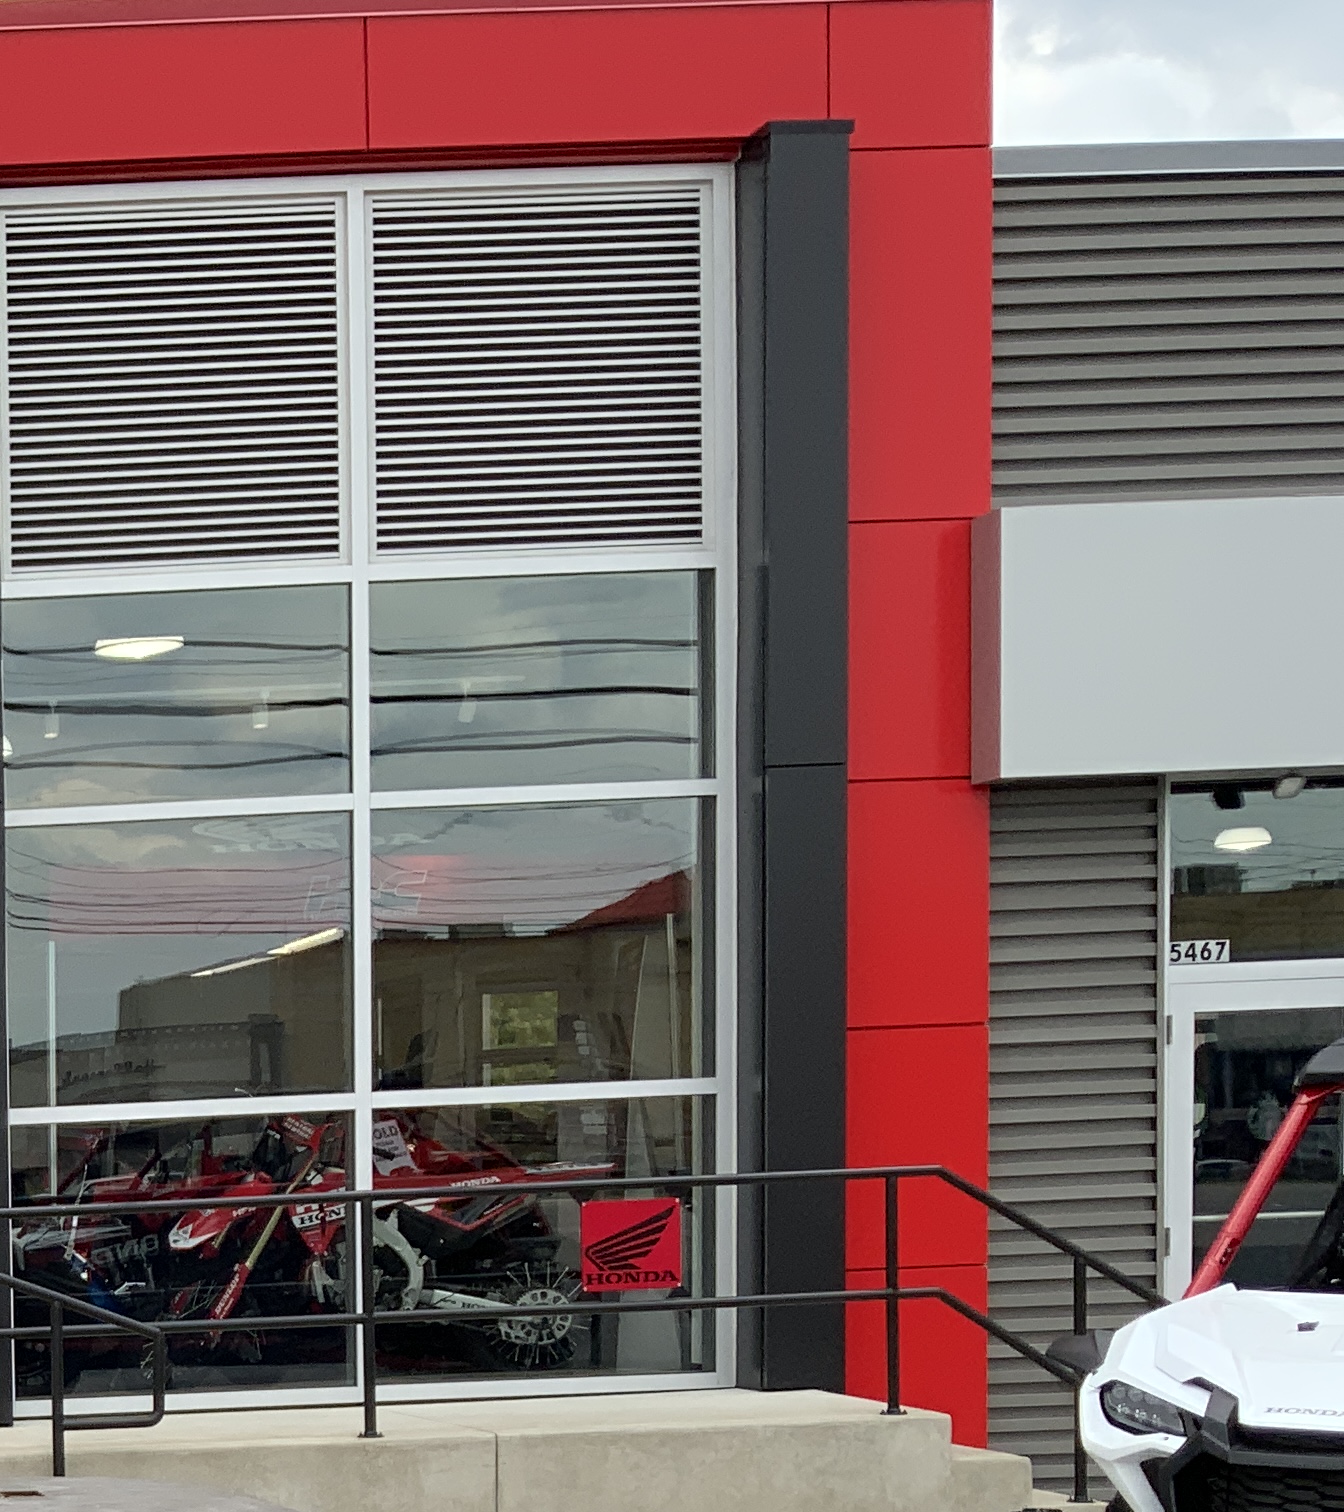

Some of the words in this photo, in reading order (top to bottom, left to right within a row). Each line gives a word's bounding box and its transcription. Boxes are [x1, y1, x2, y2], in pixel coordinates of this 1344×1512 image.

[1169, 941, 1227, 963] 5467
[373, 1126, 398, 1139] OLD
[299, 1207, 343, 1226] HON
[585, 1269, 679, 1286] HONDA
